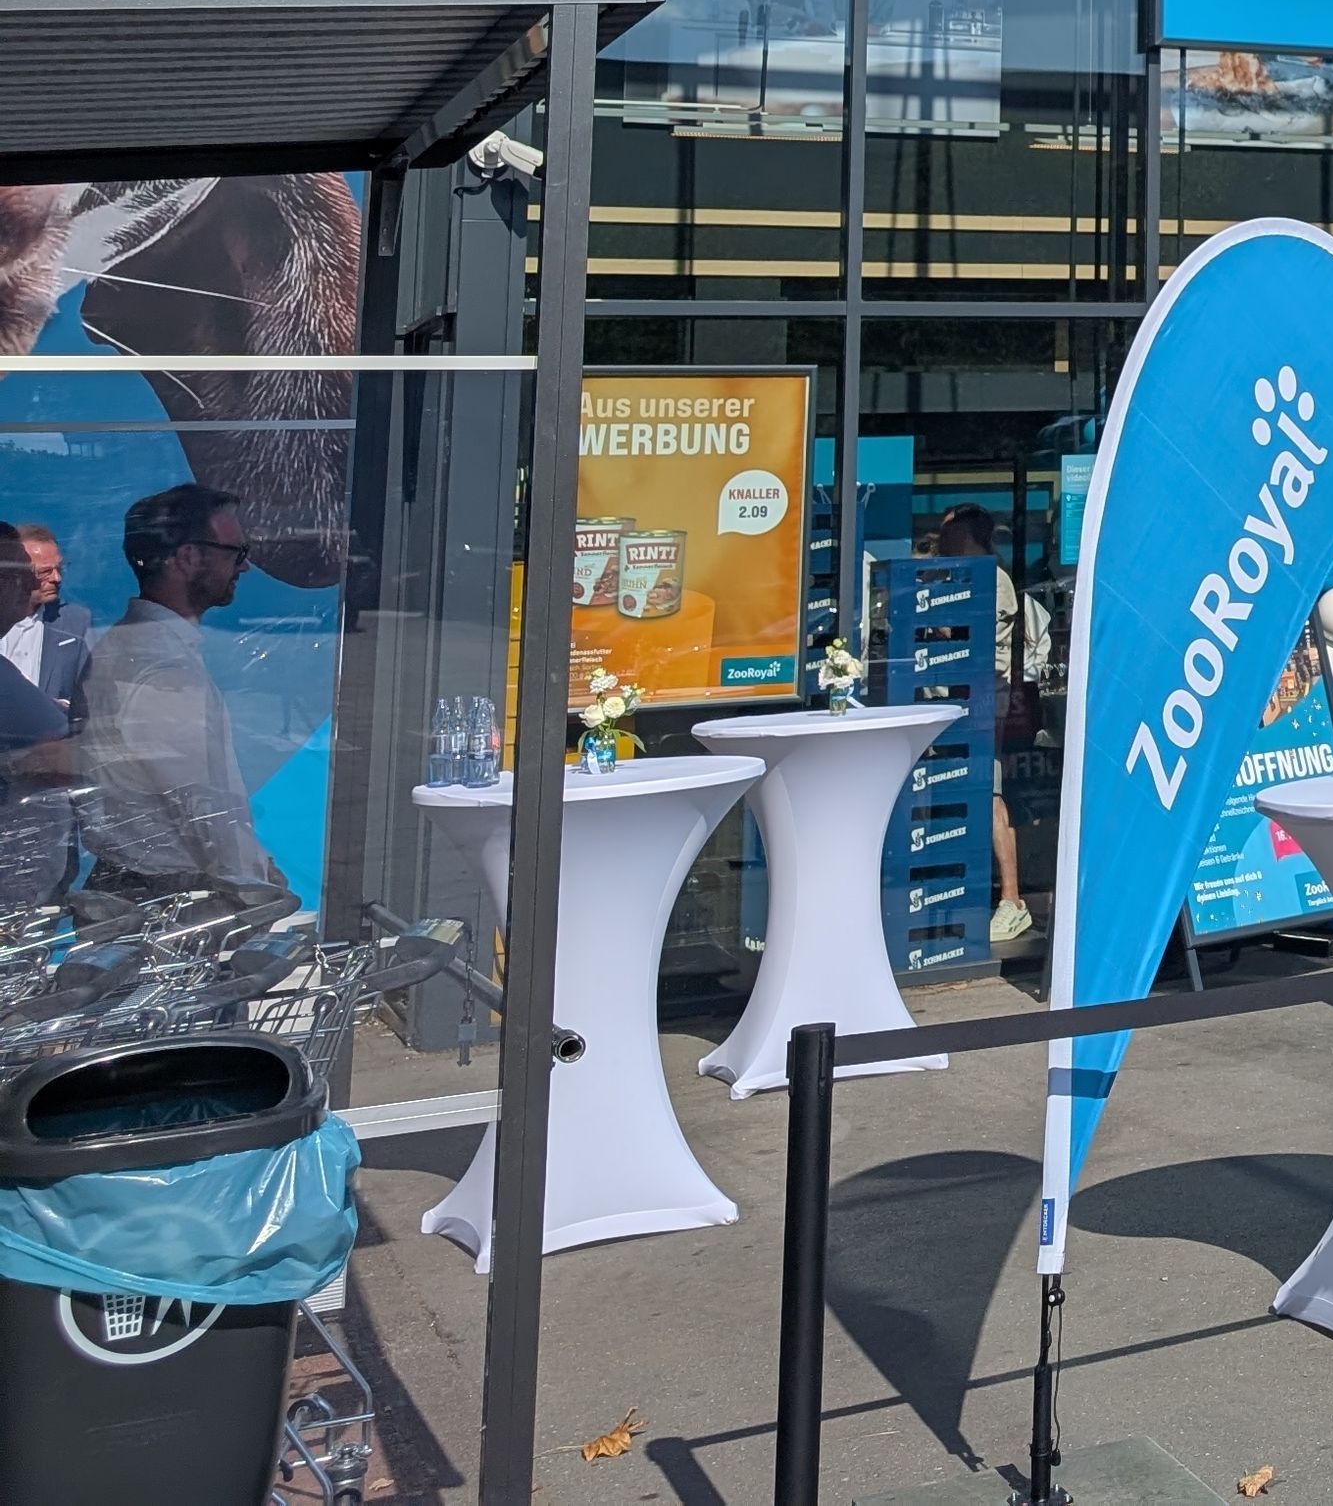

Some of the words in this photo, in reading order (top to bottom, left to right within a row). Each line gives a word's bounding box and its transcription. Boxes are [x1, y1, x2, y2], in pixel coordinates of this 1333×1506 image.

[581, 391, 631, 418] Aus
[639, 396, 755, 419] unserer
[579, 422, 751, 456] WERBUNG
[728, 488, 780, 501] KNALLER
[738, 505, 768, 519] 2.09
[628, 546, 677, 561] RINTI
[1126, 411, 1329, 811] ZooRoyal
[727, 662, 777, 680] ZooRoyal
